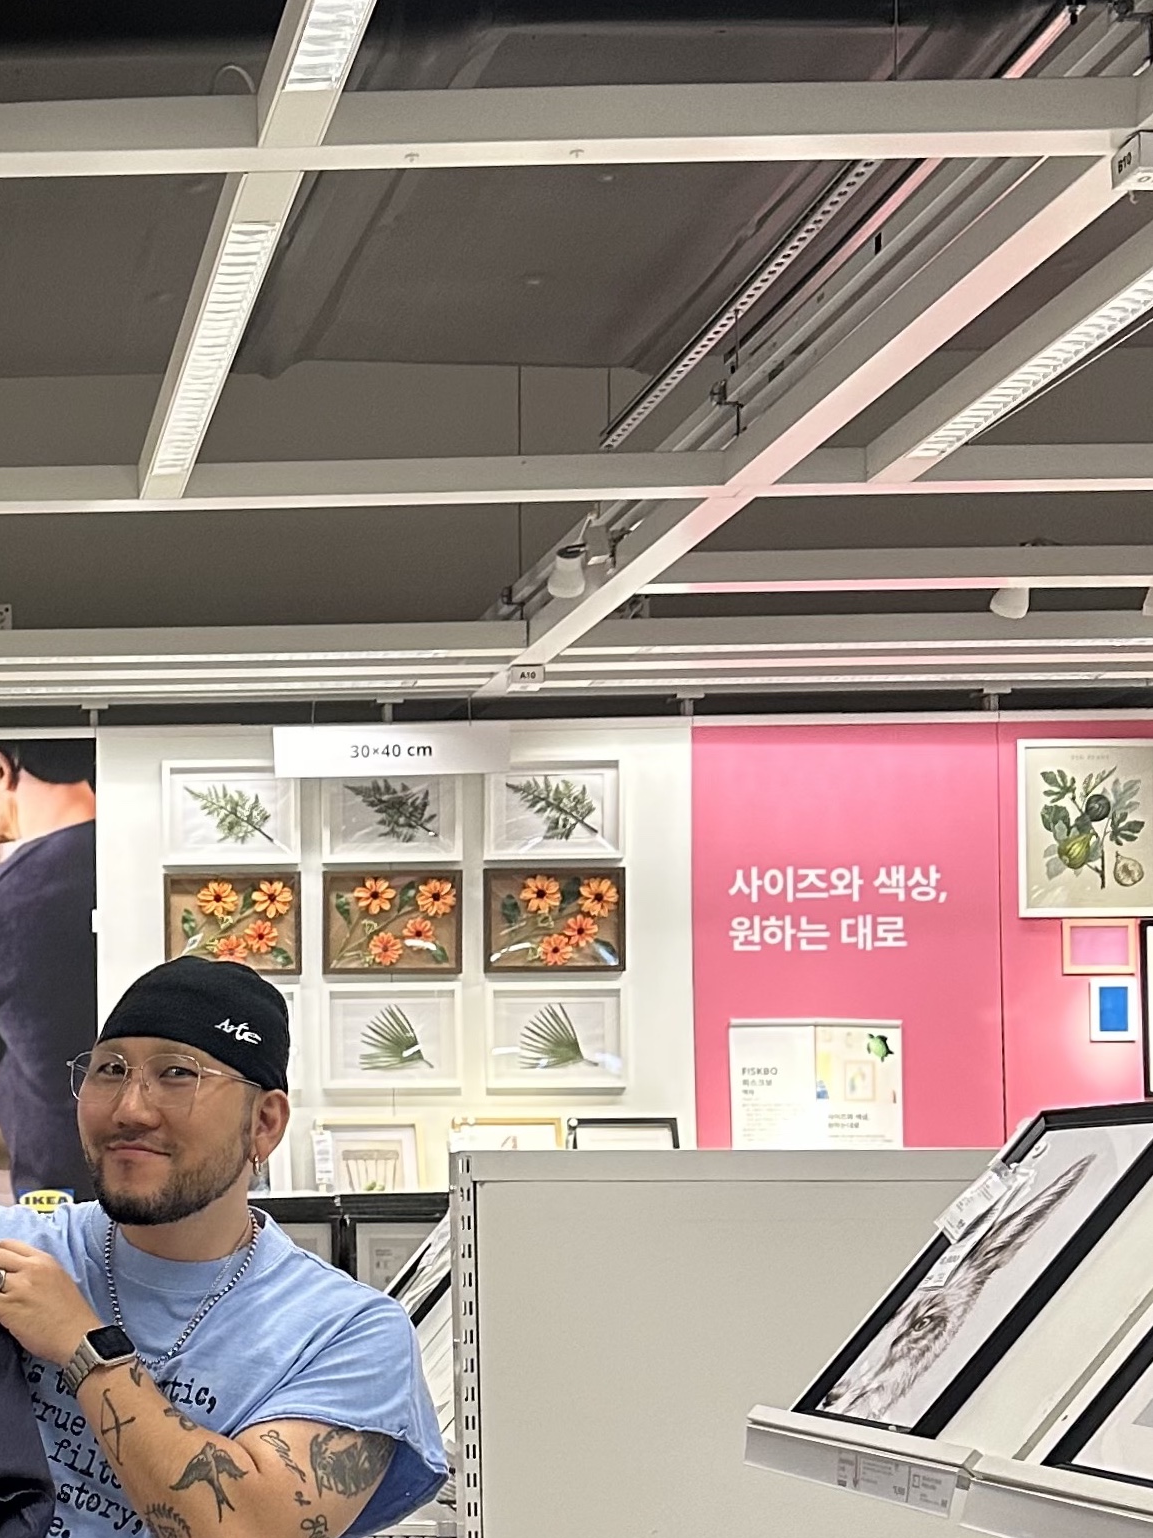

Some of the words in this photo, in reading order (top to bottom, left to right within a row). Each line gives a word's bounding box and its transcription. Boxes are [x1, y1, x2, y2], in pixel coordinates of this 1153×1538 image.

[519, 670, 537, 679] A10
[407, 744, 433, 757] cm
[728, 865, 864, 903] 사이즈와
[872, 864, 948, 904] 색상,
[728, 914, 831, 952] 원하는
[840, 914, 908, 951] 대로
[741, 1067, 778, 1076] FISKBO
[24, 1196, 69, 1205] IKEA
[56, 1482, 145, 1536] story,
